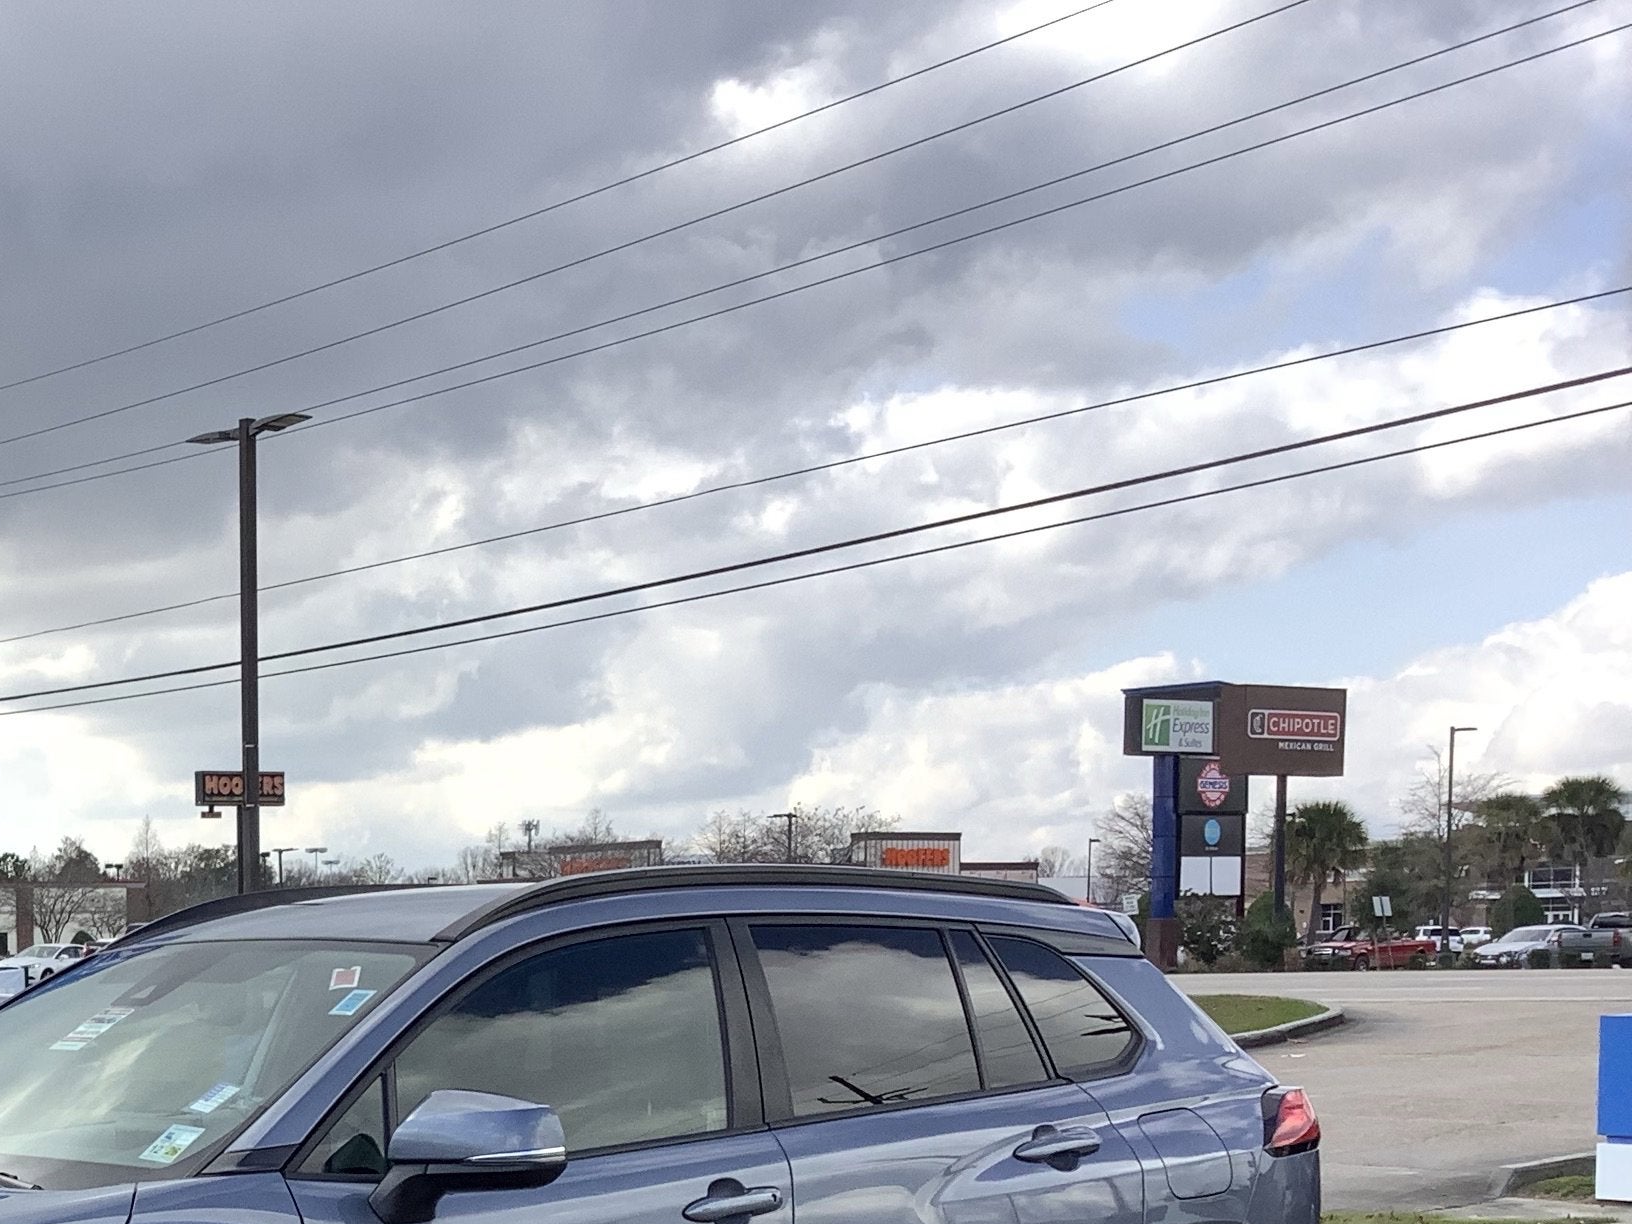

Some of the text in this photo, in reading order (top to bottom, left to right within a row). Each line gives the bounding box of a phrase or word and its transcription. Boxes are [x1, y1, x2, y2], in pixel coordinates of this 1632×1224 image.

[1173, 717, 1210, 736] Express
[1269, 717, 1336, 734] CHIPOTLE
[1278, 742, 1334, 752] MEXICAN GRILL
[204, 775, 284, 796] HOORS
